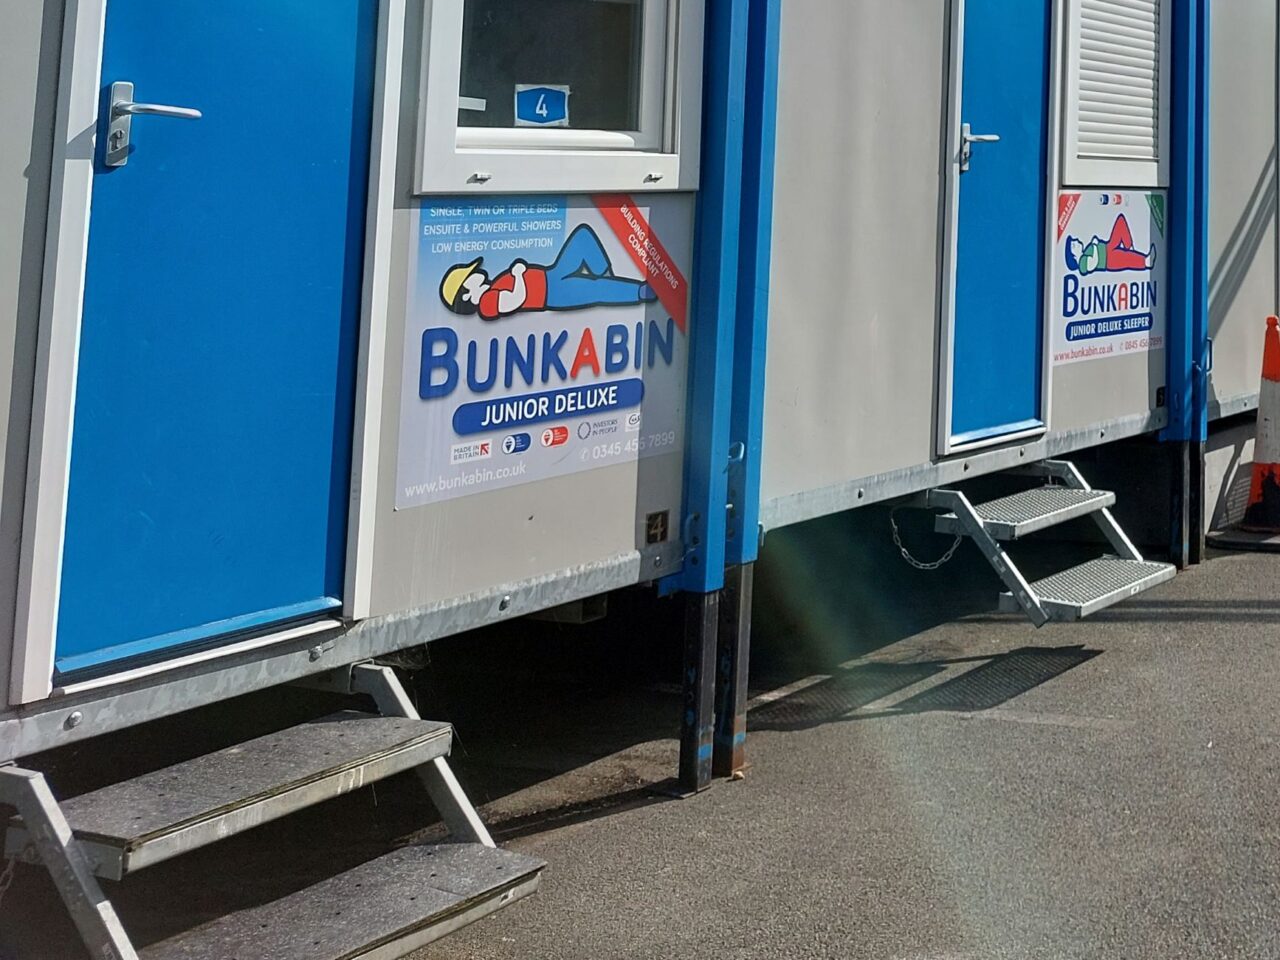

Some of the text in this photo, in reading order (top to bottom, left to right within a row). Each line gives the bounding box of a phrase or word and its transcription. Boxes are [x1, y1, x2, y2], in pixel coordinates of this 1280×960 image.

[535, 93, 548, 118] 4
[430, 203, 558, 217] SINGLE, TWIN OR TRIPLE BEDS
[423, 220, 562, 236] ENSUITE & POWERFUL SHOWERS
[431, 238, 553, 254] LOW ENERGY CONSUMPTION
[620, 204, 679, 290] BUILDING REGULATIONS
[628, 234, 660, 277] COMPLIANT
[1063, 274, 1158, 318] BUNKABIN
[1069, 316, 1149, 340] JUNIOR DELUXE SLEEPER
[418, 317, 675, 400] BUNKABIN
[1053, 343, 1113, 361] www.bunkabin.co.uk
[481, 386, 618, 427] JUNIOR DELUXE
[453, 446, 472, 454] MADE
[453, 451, 480, 460] BRITAIN
[592, 442, 621, 459] 0345
[624, 438, 645, 452] 456
[404, 461, 527, 497] www.bunkabin.co.uk
[649, 514, 665, 542] 4
